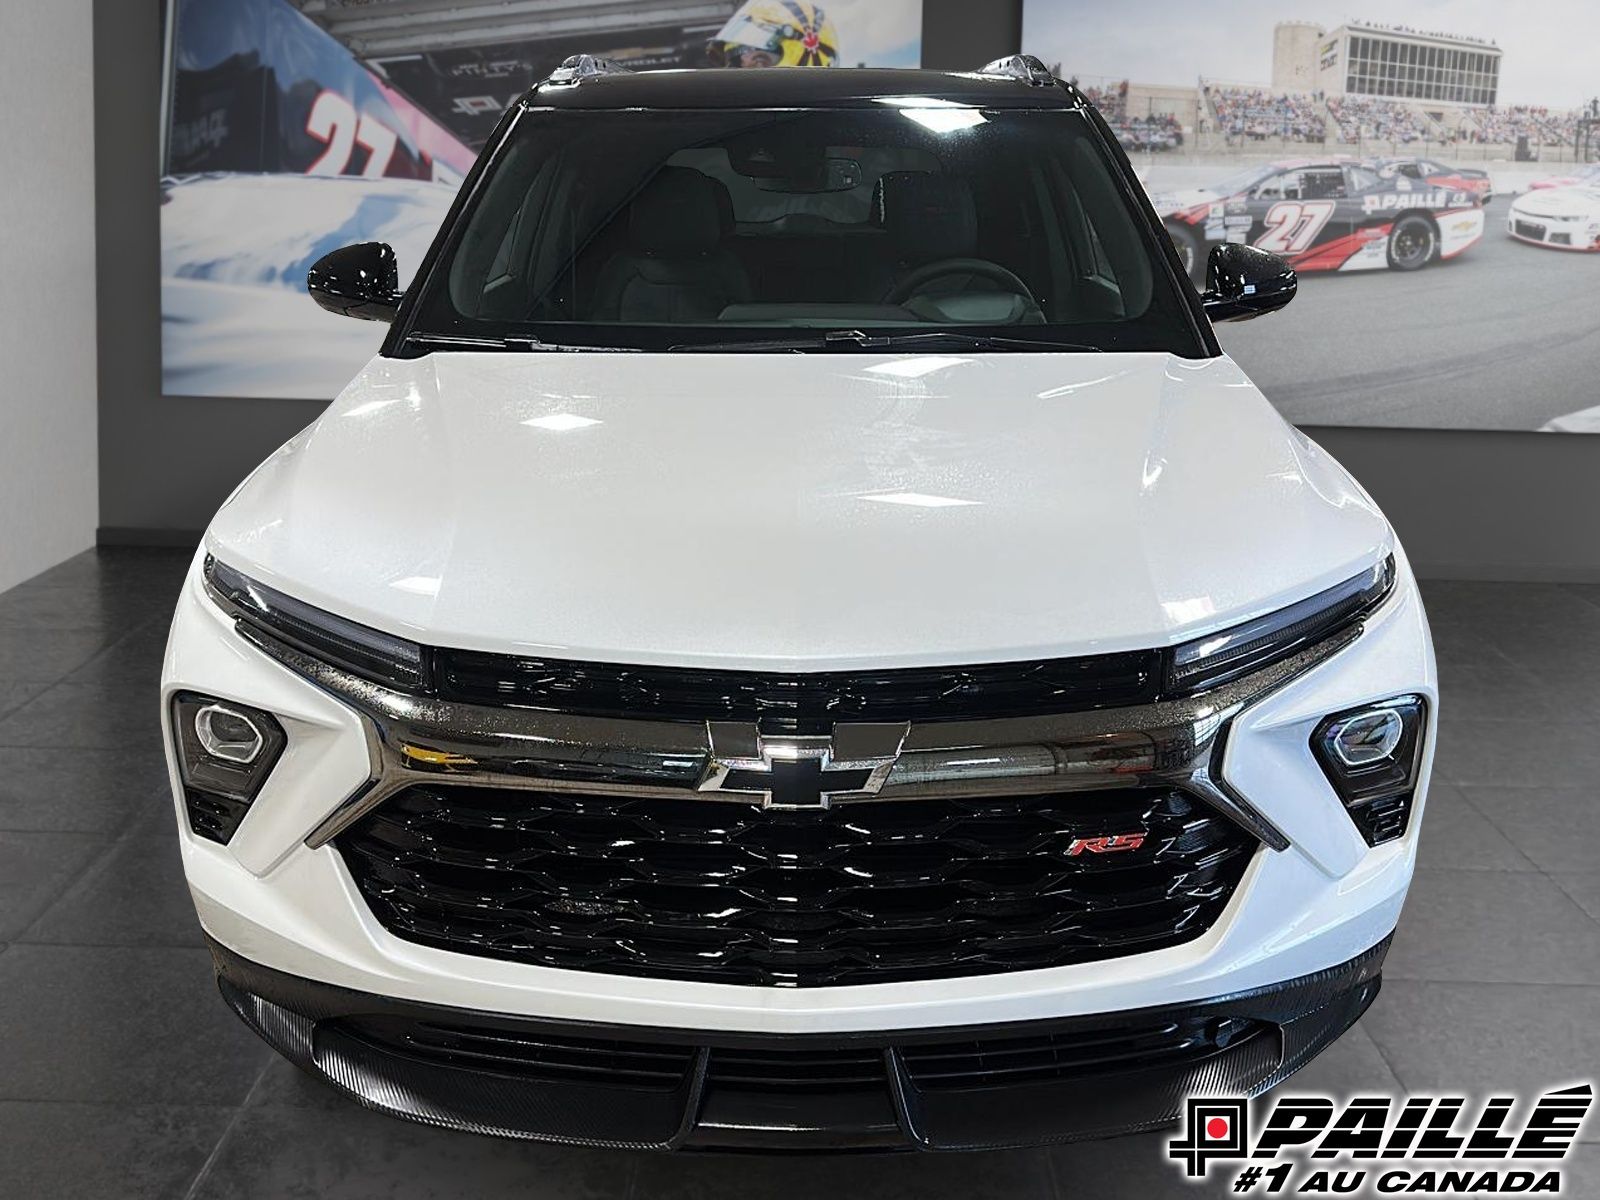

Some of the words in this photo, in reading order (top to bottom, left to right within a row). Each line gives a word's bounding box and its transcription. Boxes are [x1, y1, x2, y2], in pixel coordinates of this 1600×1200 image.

[305, 89, 397, 177] 27
[1253, 200, 1336, 255] 27
[1064, 833, 1144, 856] RS
